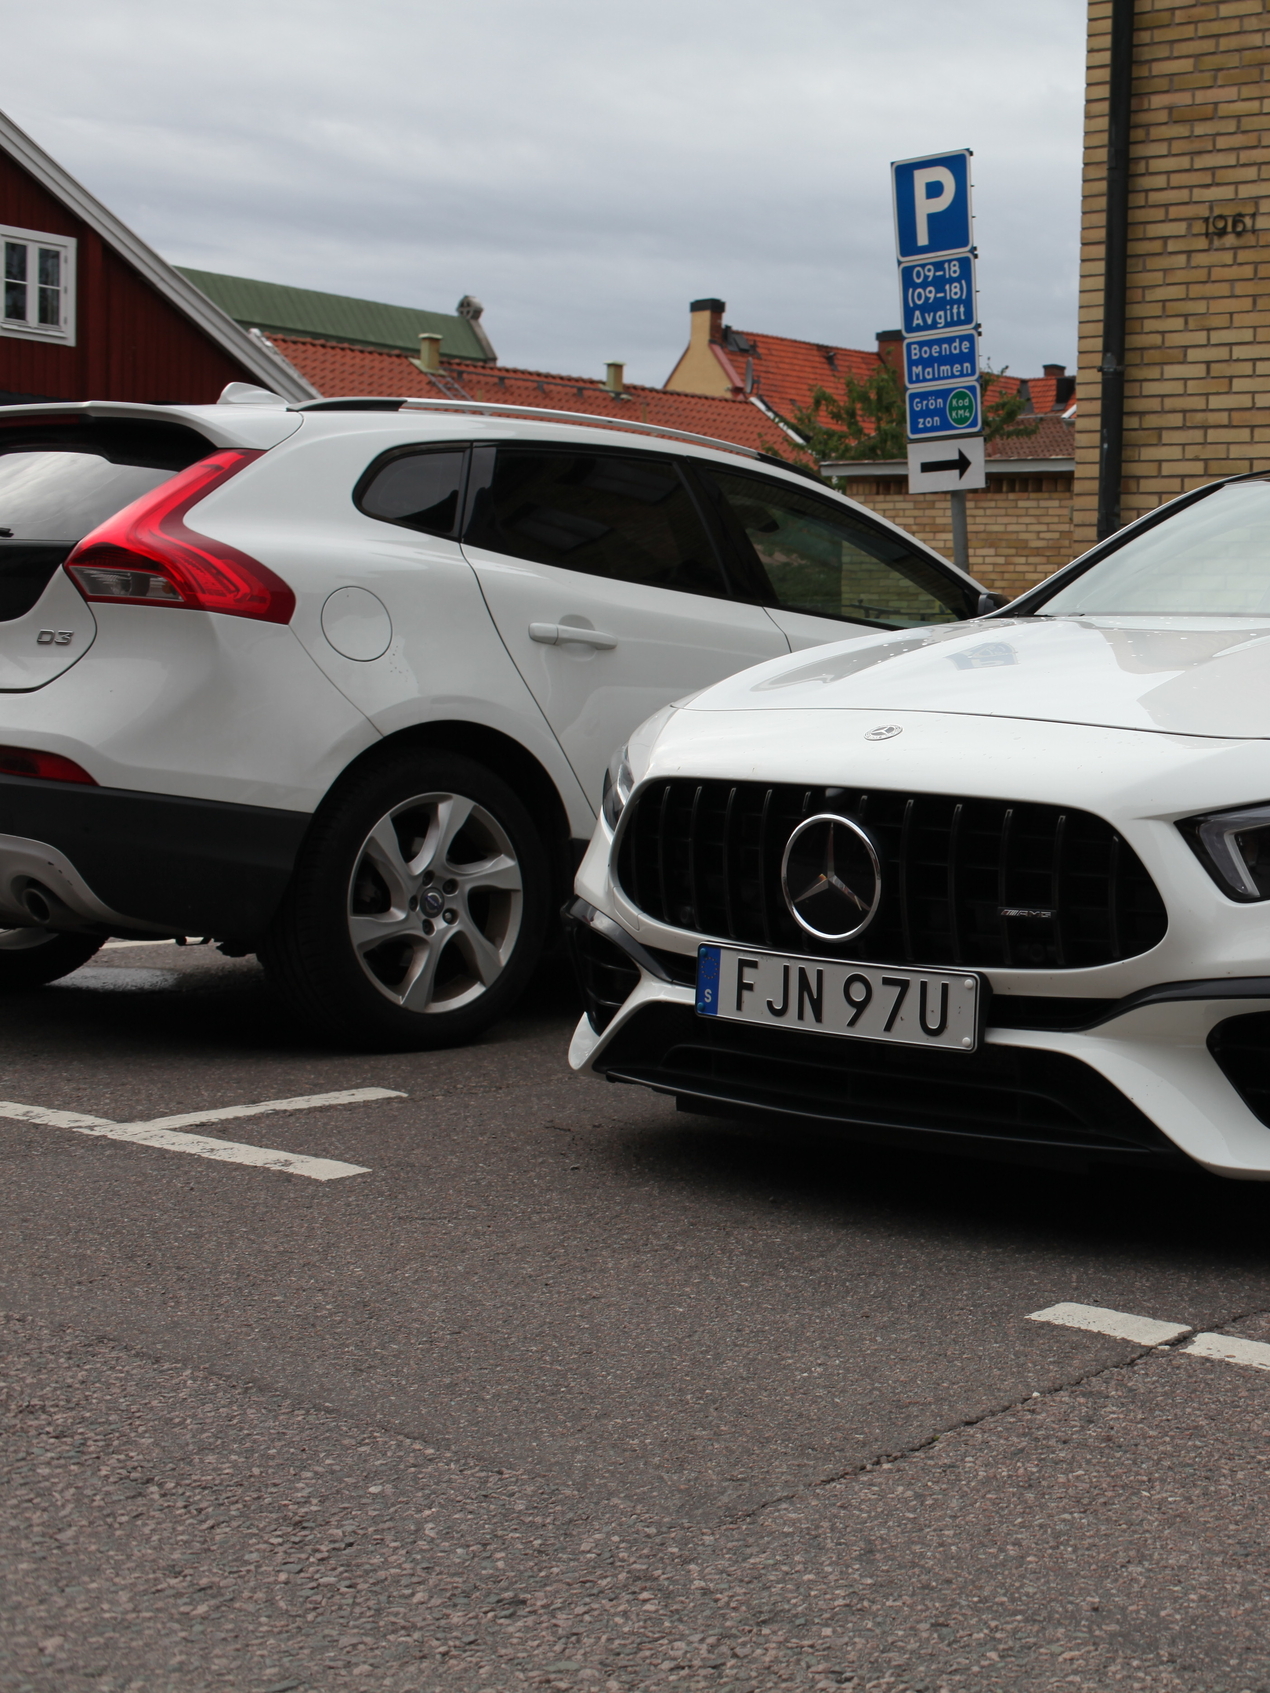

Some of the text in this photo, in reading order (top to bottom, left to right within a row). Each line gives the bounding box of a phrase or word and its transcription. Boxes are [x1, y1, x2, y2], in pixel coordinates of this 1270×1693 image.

[912, 165, 956, 247] P
[1201, 211, 1257, 240] 1961
[912, 260, 961, 283] 09-18
[907, 279, 968, 308] (09-18)
[912, 303, 966, 328] Avgift
[910, 338, 971, 360] Boende
[911, 361, 972, 381] Malmen
[912, 396, 944, 411] Grön
[952, 396, 970, 407] Kod
[917, 416, 941, 429] zon
[951, 408, 971, 419] KM4
[36, 628, 74, 645] D3
[1014, 909, 1052, 918] AMG
[703, 956, 950, 1037] S FJN 97U
